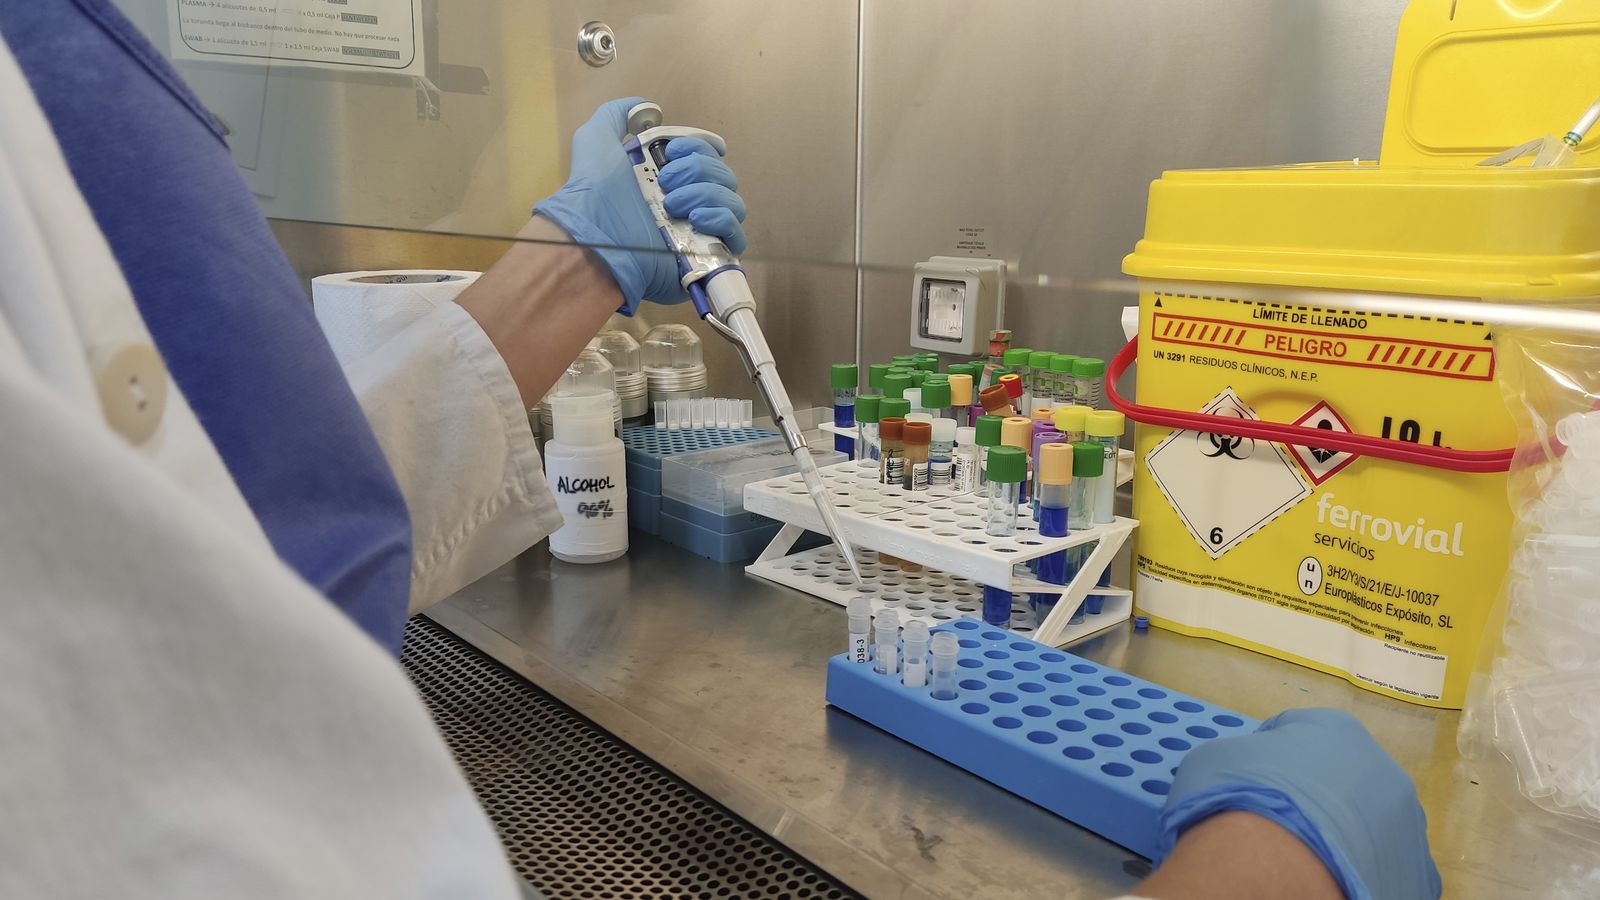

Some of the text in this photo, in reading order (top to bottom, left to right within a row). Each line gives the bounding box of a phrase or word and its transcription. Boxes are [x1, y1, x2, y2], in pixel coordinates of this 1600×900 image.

[1253, 307, 1368, 329] LÍMITE DE LLENADO
[1264, 333, 1347, 358] PELIGRO
[1153, 350, 1319, 382] UN 3291 RESIDUOS CLÍNICOS, N.E.P.
[557, 476, 616, 494] ALCOHOL
[1209, 527, 1224, 545] 6
[1317, 492, 1465, 557] ferrovial
[1313, 531, 1376, 561] servicios
[1189, 571, 1212, 581] recogida
[1217, 576, 1246, 588] eliminación
[1256, 586, 1273, 596] objeto
[1281, 593, 1308, 605] requisitos
[1308, 601, 1338, 612] especiales
[1326, 564, 1440, 607] 3H2/Y3/S/21/E/J-10037
[1200, 580, 1236, 593] determinados
[1315, 610, 1341, 622] toxicidad
[1385, 632, 1401, 642] HP9
[1324, 582, 1454, 629] Europlásticos Expósito, SL
[1384, 643, 1409, 654] Recipiente
[1417, 652, 1445, 661] reutilizable
[1420, 692, 1440, 700] vigente
